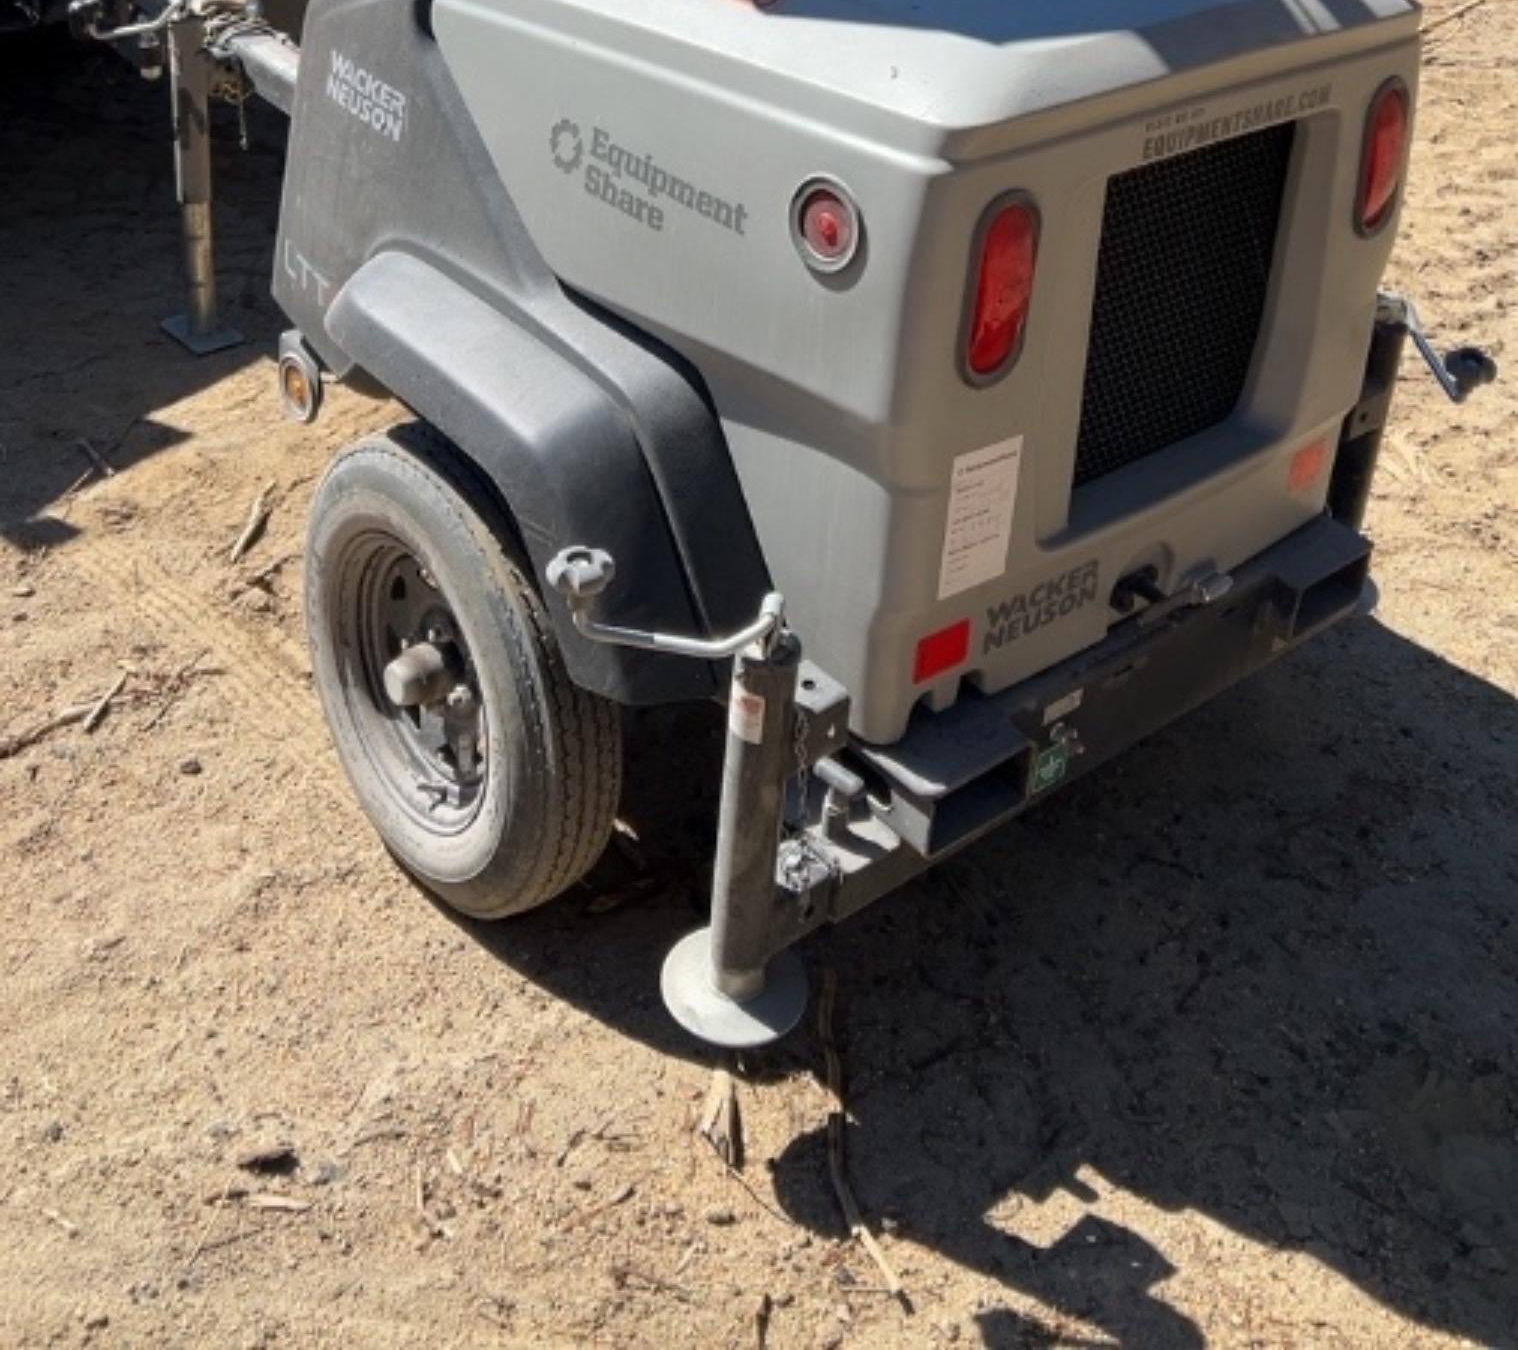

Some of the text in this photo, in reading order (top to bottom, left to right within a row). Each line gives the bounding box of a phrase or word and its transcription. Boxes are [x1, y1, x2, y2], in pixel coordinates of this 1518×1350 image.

[326, 72, 403, 143] NEUSON
[331, 48, 406, 118] WACKER
[583, 163, 665, 233] Share
[590, 124, 750, 237] Equipment
[982, 587, 1097, 656] NEUSON
[986, 558, 1100, 628] WACKER
